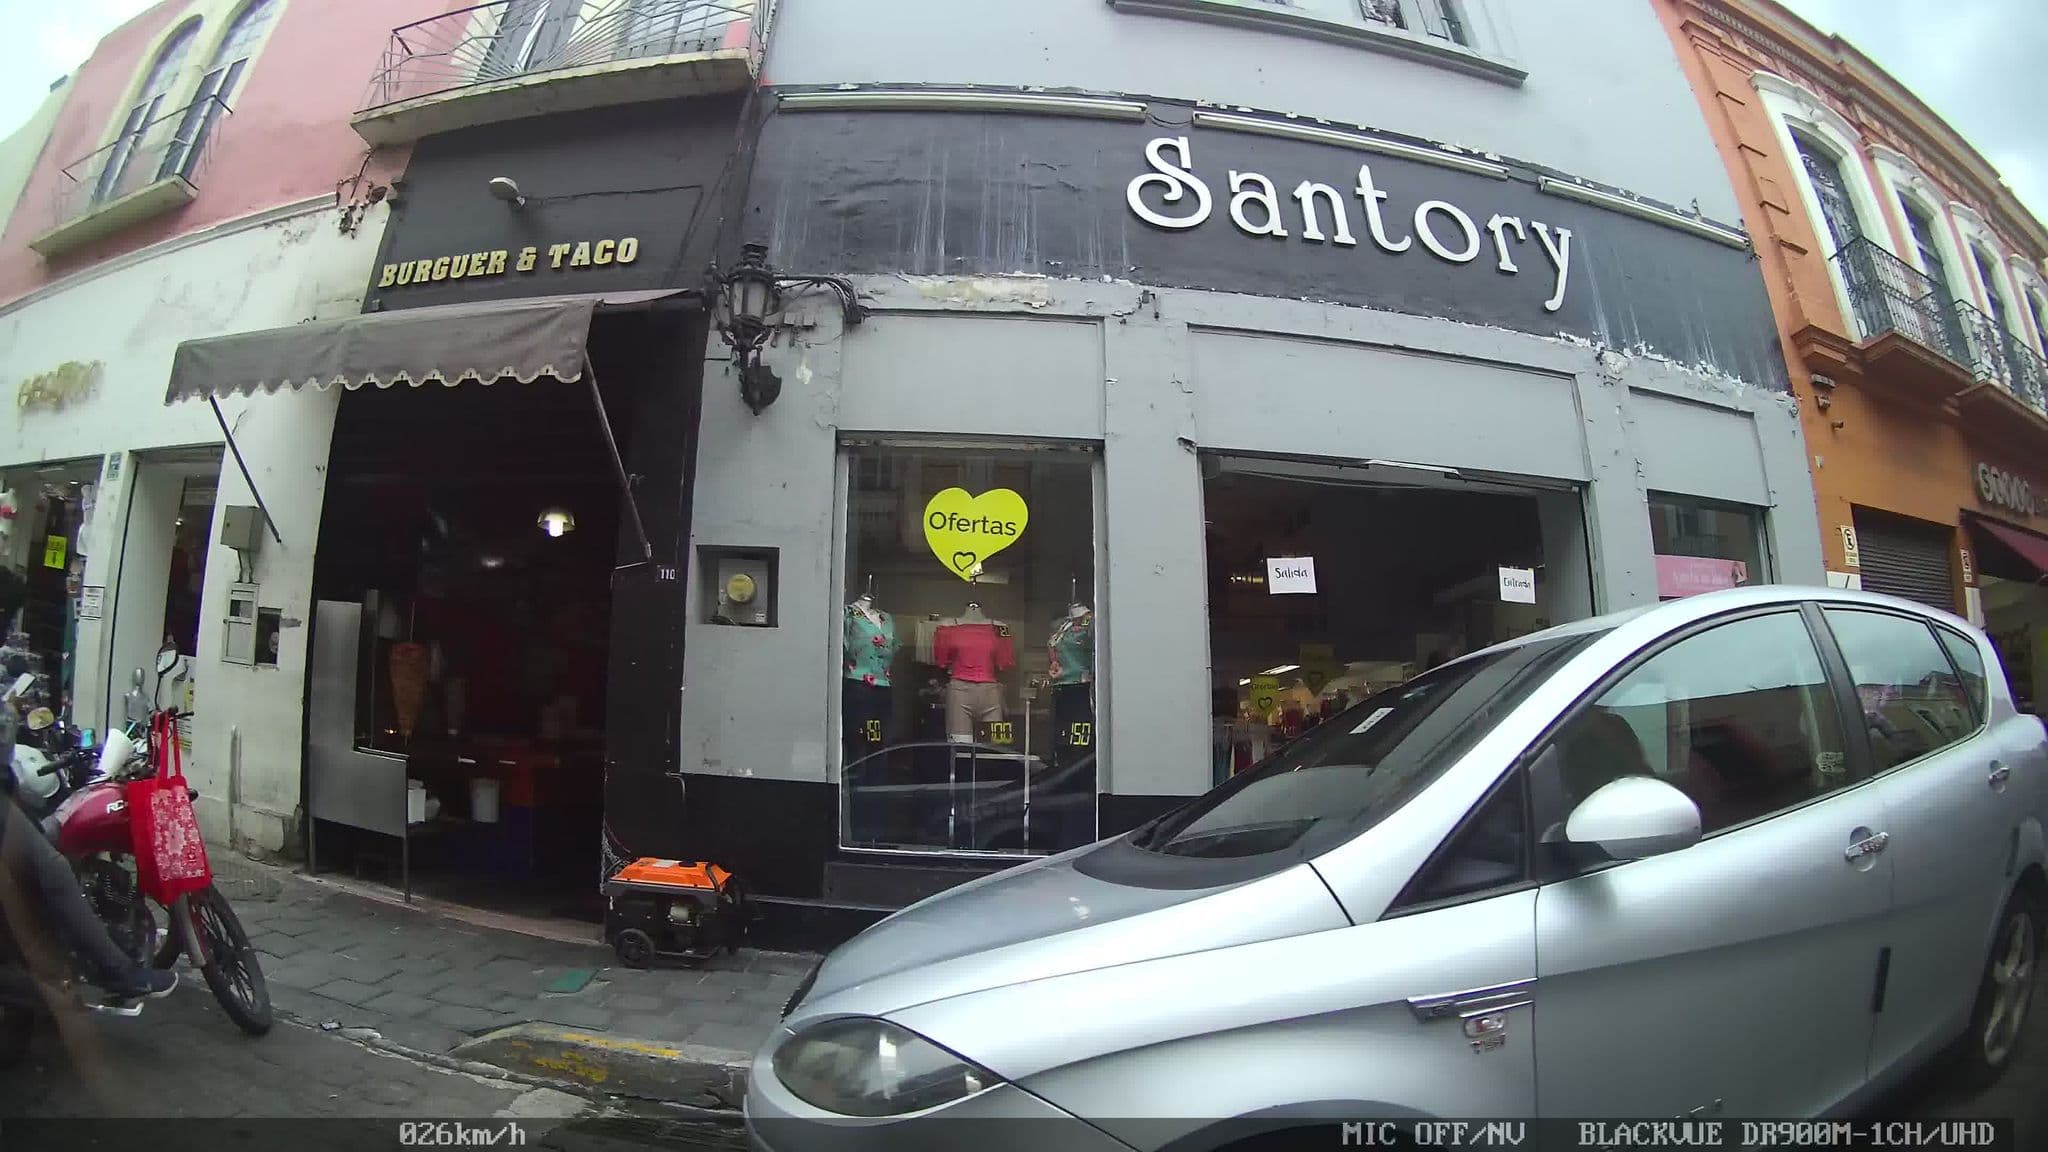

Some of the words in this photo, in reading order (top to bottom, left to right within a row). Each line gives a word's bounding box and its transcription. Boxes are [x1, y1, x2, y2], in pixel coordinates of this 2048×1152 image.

[1126, 136, 1573, 312] Santory
[378, 250, 508, 288] BURGUER
[516, 246, 537, 271] &
[549, 237, 639, 268] TACO
[929, 511, 1017, 536] Ofertas
[660, 568, 676, 580] 110
[1275, 566, 1308, 579] Salida
[1070, 722, 1091, 746] 150
